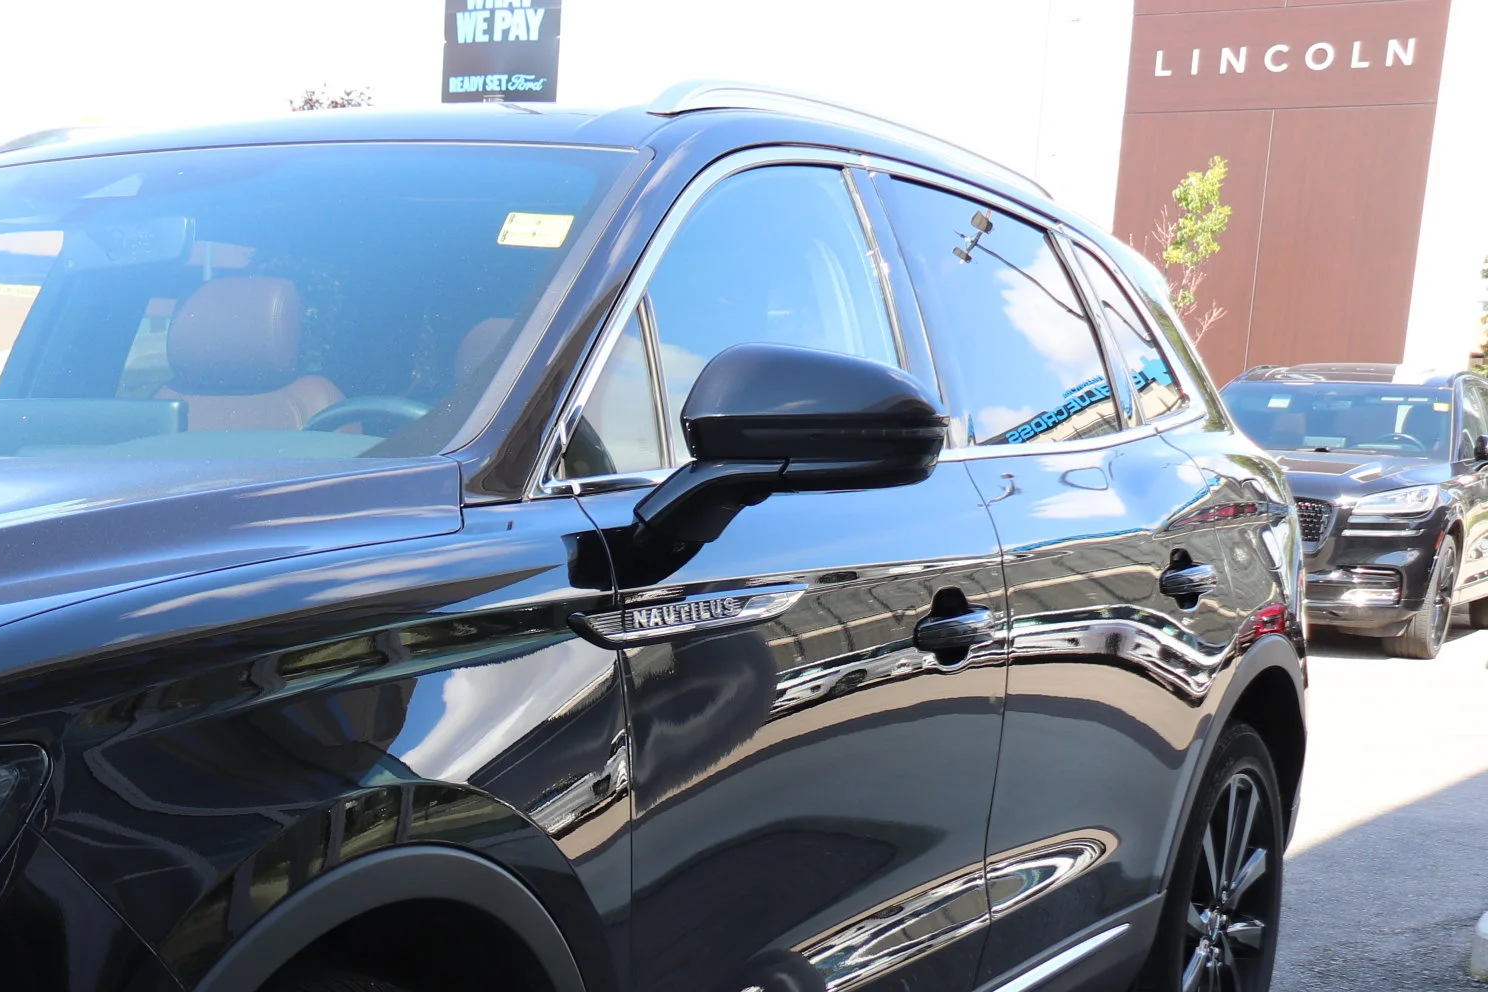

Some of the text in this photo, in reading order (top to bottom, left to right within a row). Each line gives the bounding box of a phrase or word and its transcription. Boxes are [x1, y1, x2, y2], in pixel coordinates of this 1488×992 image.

[456, 8, 545, 44] WE PAY
[1154, 37, 1417, 77] LINCOLN
[449, 74, 544, 93] READY SET Ford
[633, 597, 735, 629] NAUTILUS
